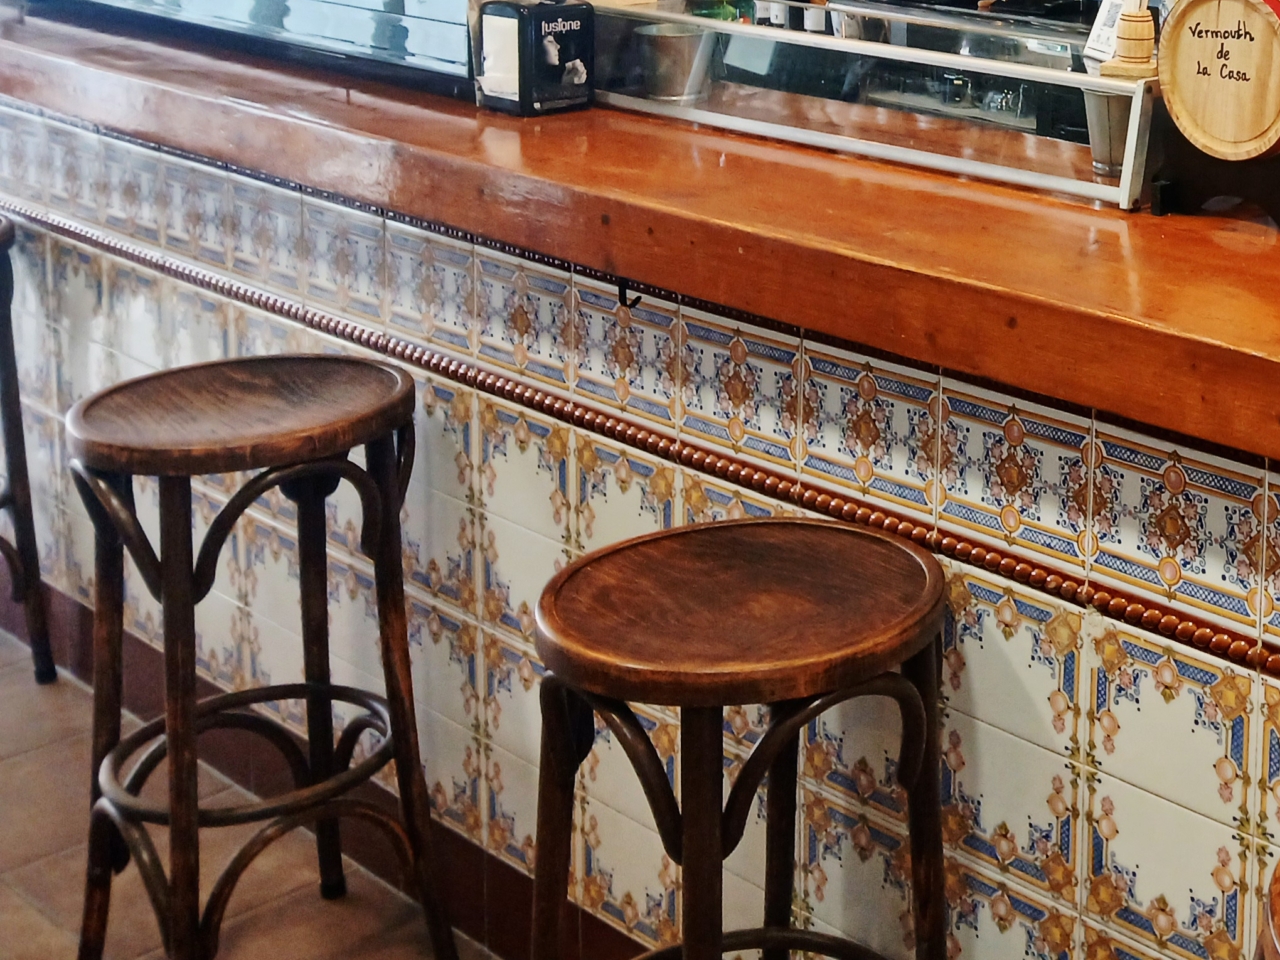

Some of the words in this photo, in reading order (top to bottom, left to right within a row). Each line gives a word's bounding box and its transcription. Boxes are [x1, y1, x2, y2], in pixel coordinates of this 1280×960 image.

[541, 17, 581, 36] fusione
[1189, 20, 1255, 42] Vermouth
[1216, 46, 1231, 62] de
[1220, 62, 1251, 82] Casa
